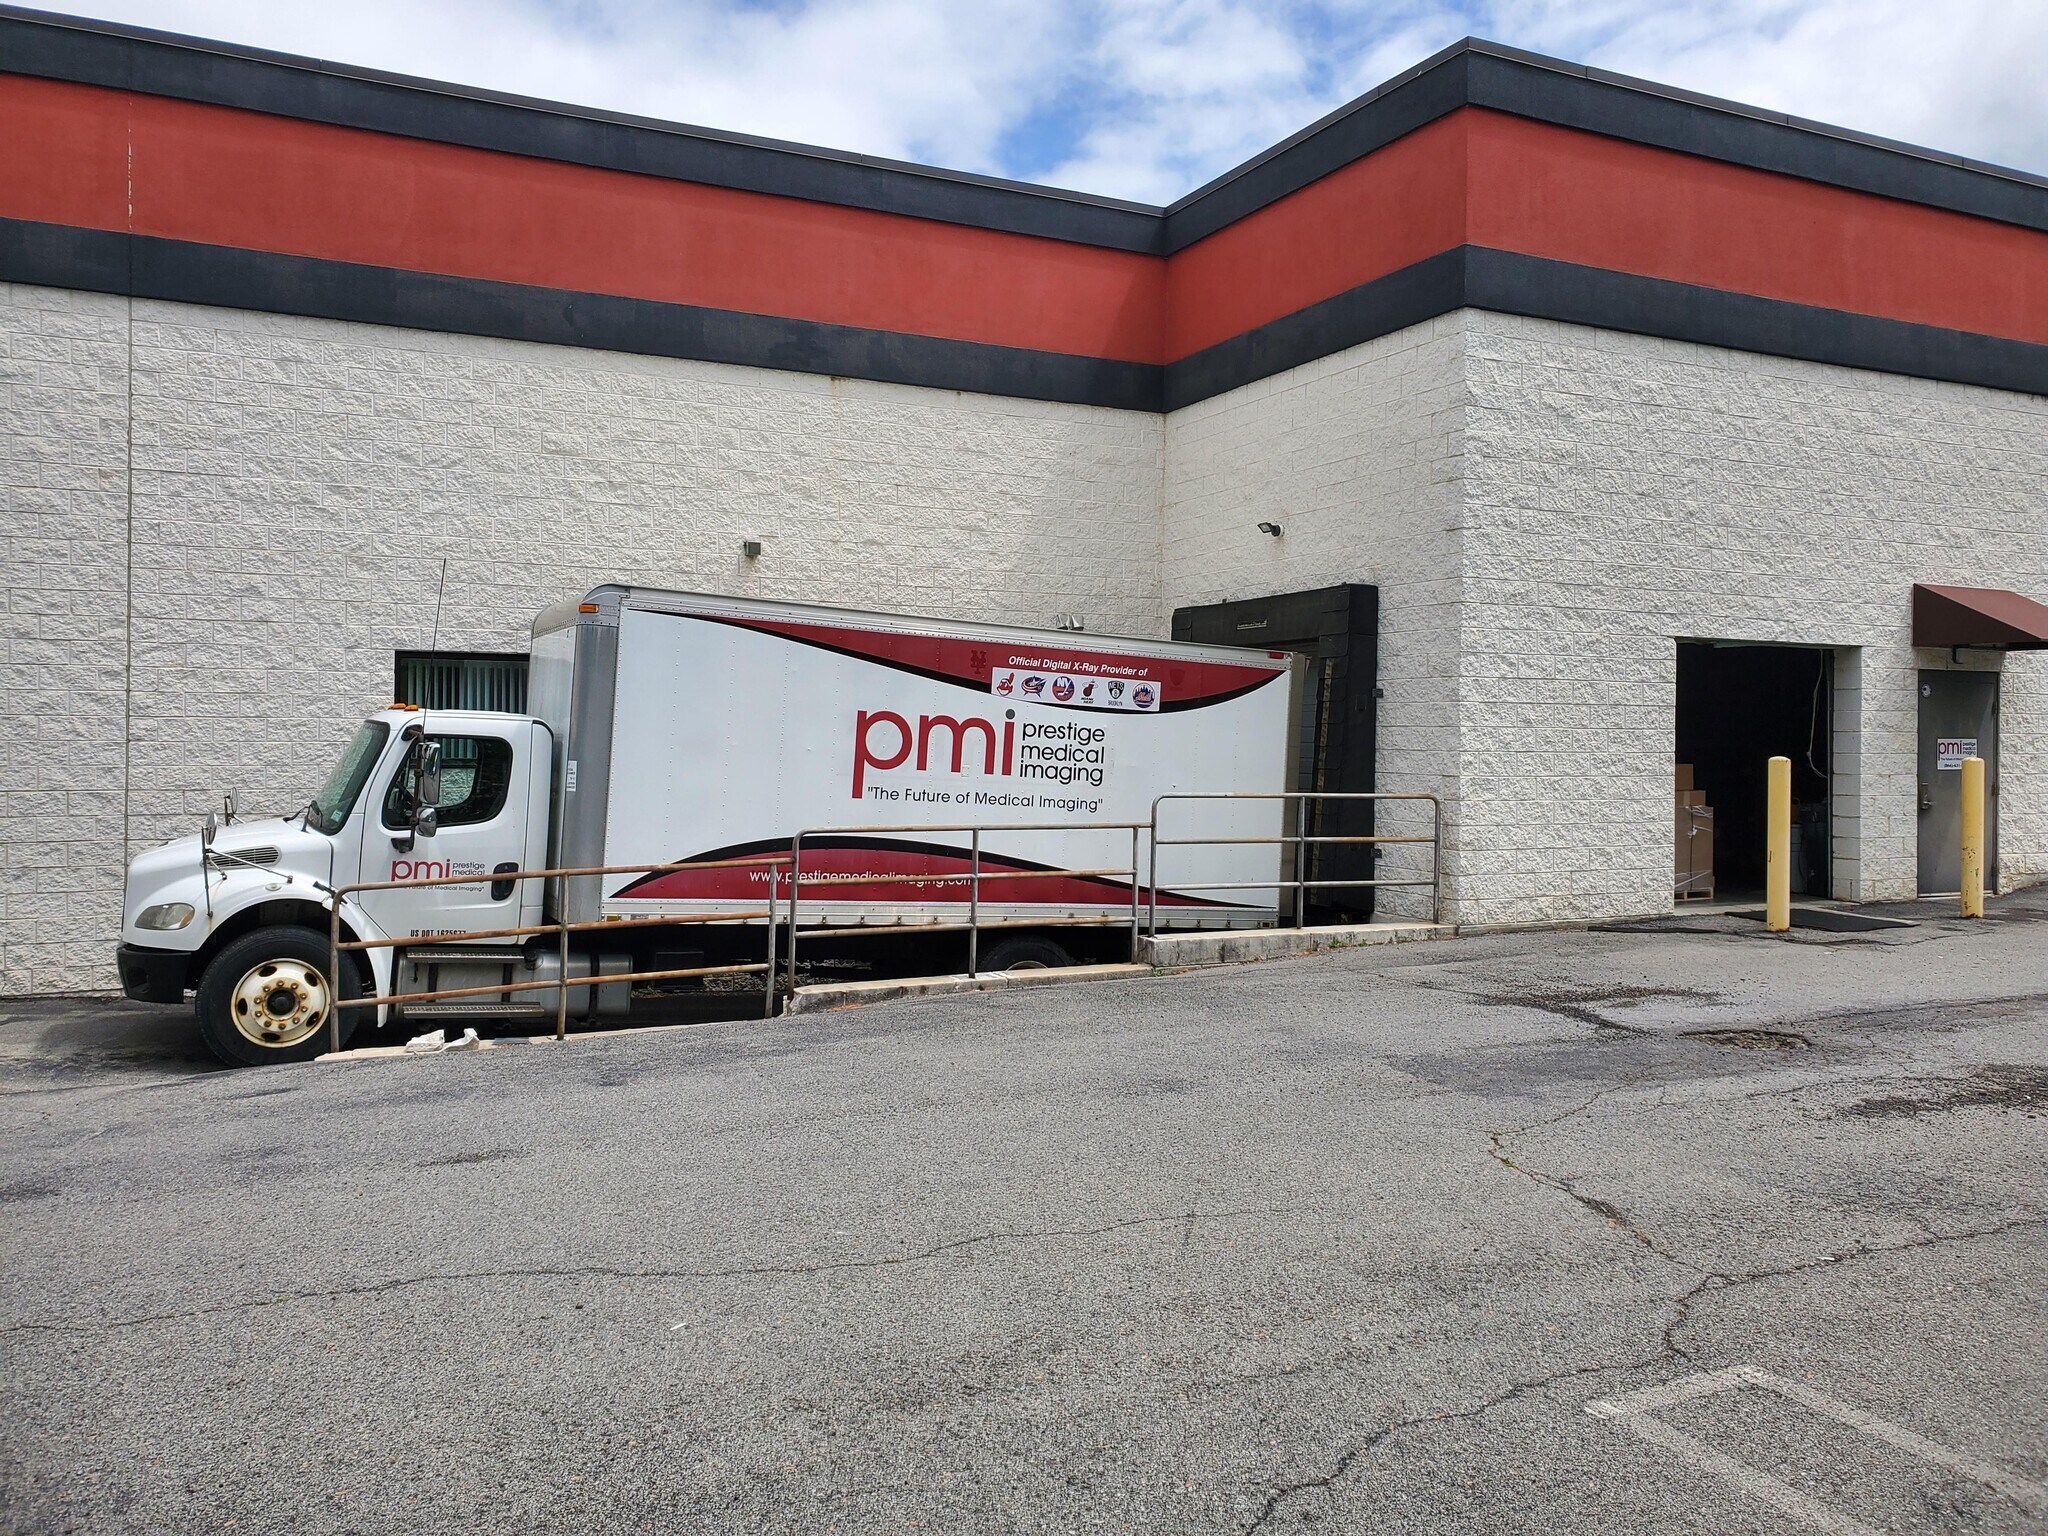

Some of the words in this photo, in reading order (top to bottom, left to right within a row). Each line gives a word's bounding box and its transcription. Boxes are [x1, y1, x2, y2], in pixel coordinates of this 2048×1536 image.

[1008, 655, 1041, 668] Official
[1042, 658, 1072, 671] Digital
[1072, 661, 1099, 674] X-Ray
[1100, 664, 1138, 676] Provider
[1138, 667, 1149, 677] of
[1108, 681, 1124, 691] NETS
[1022, 721, 1105, 746] prestige
[852, 708, 1016, 799] pmi
[1020, 743, 1105, 764] medical
[1938, 740, 1963, 761] pmi
[1019, 760, 1104, 787] imaging
[867, 786, 900, 801] "The
[904, 788, 951, 804] Future
[955, 791, 972, 804] of
[974, 792, 1035, 808] Medical
[1038, 795, 1104, 814] Imaging"
[391, 859, 450, 881] pmi
[453, 862, 485, 870] prestige
[749, 870, 971, 887] www.pestigemedicgg.co
[410, 929, 420, 938] US
[421, 929, 435, 938] DOT
